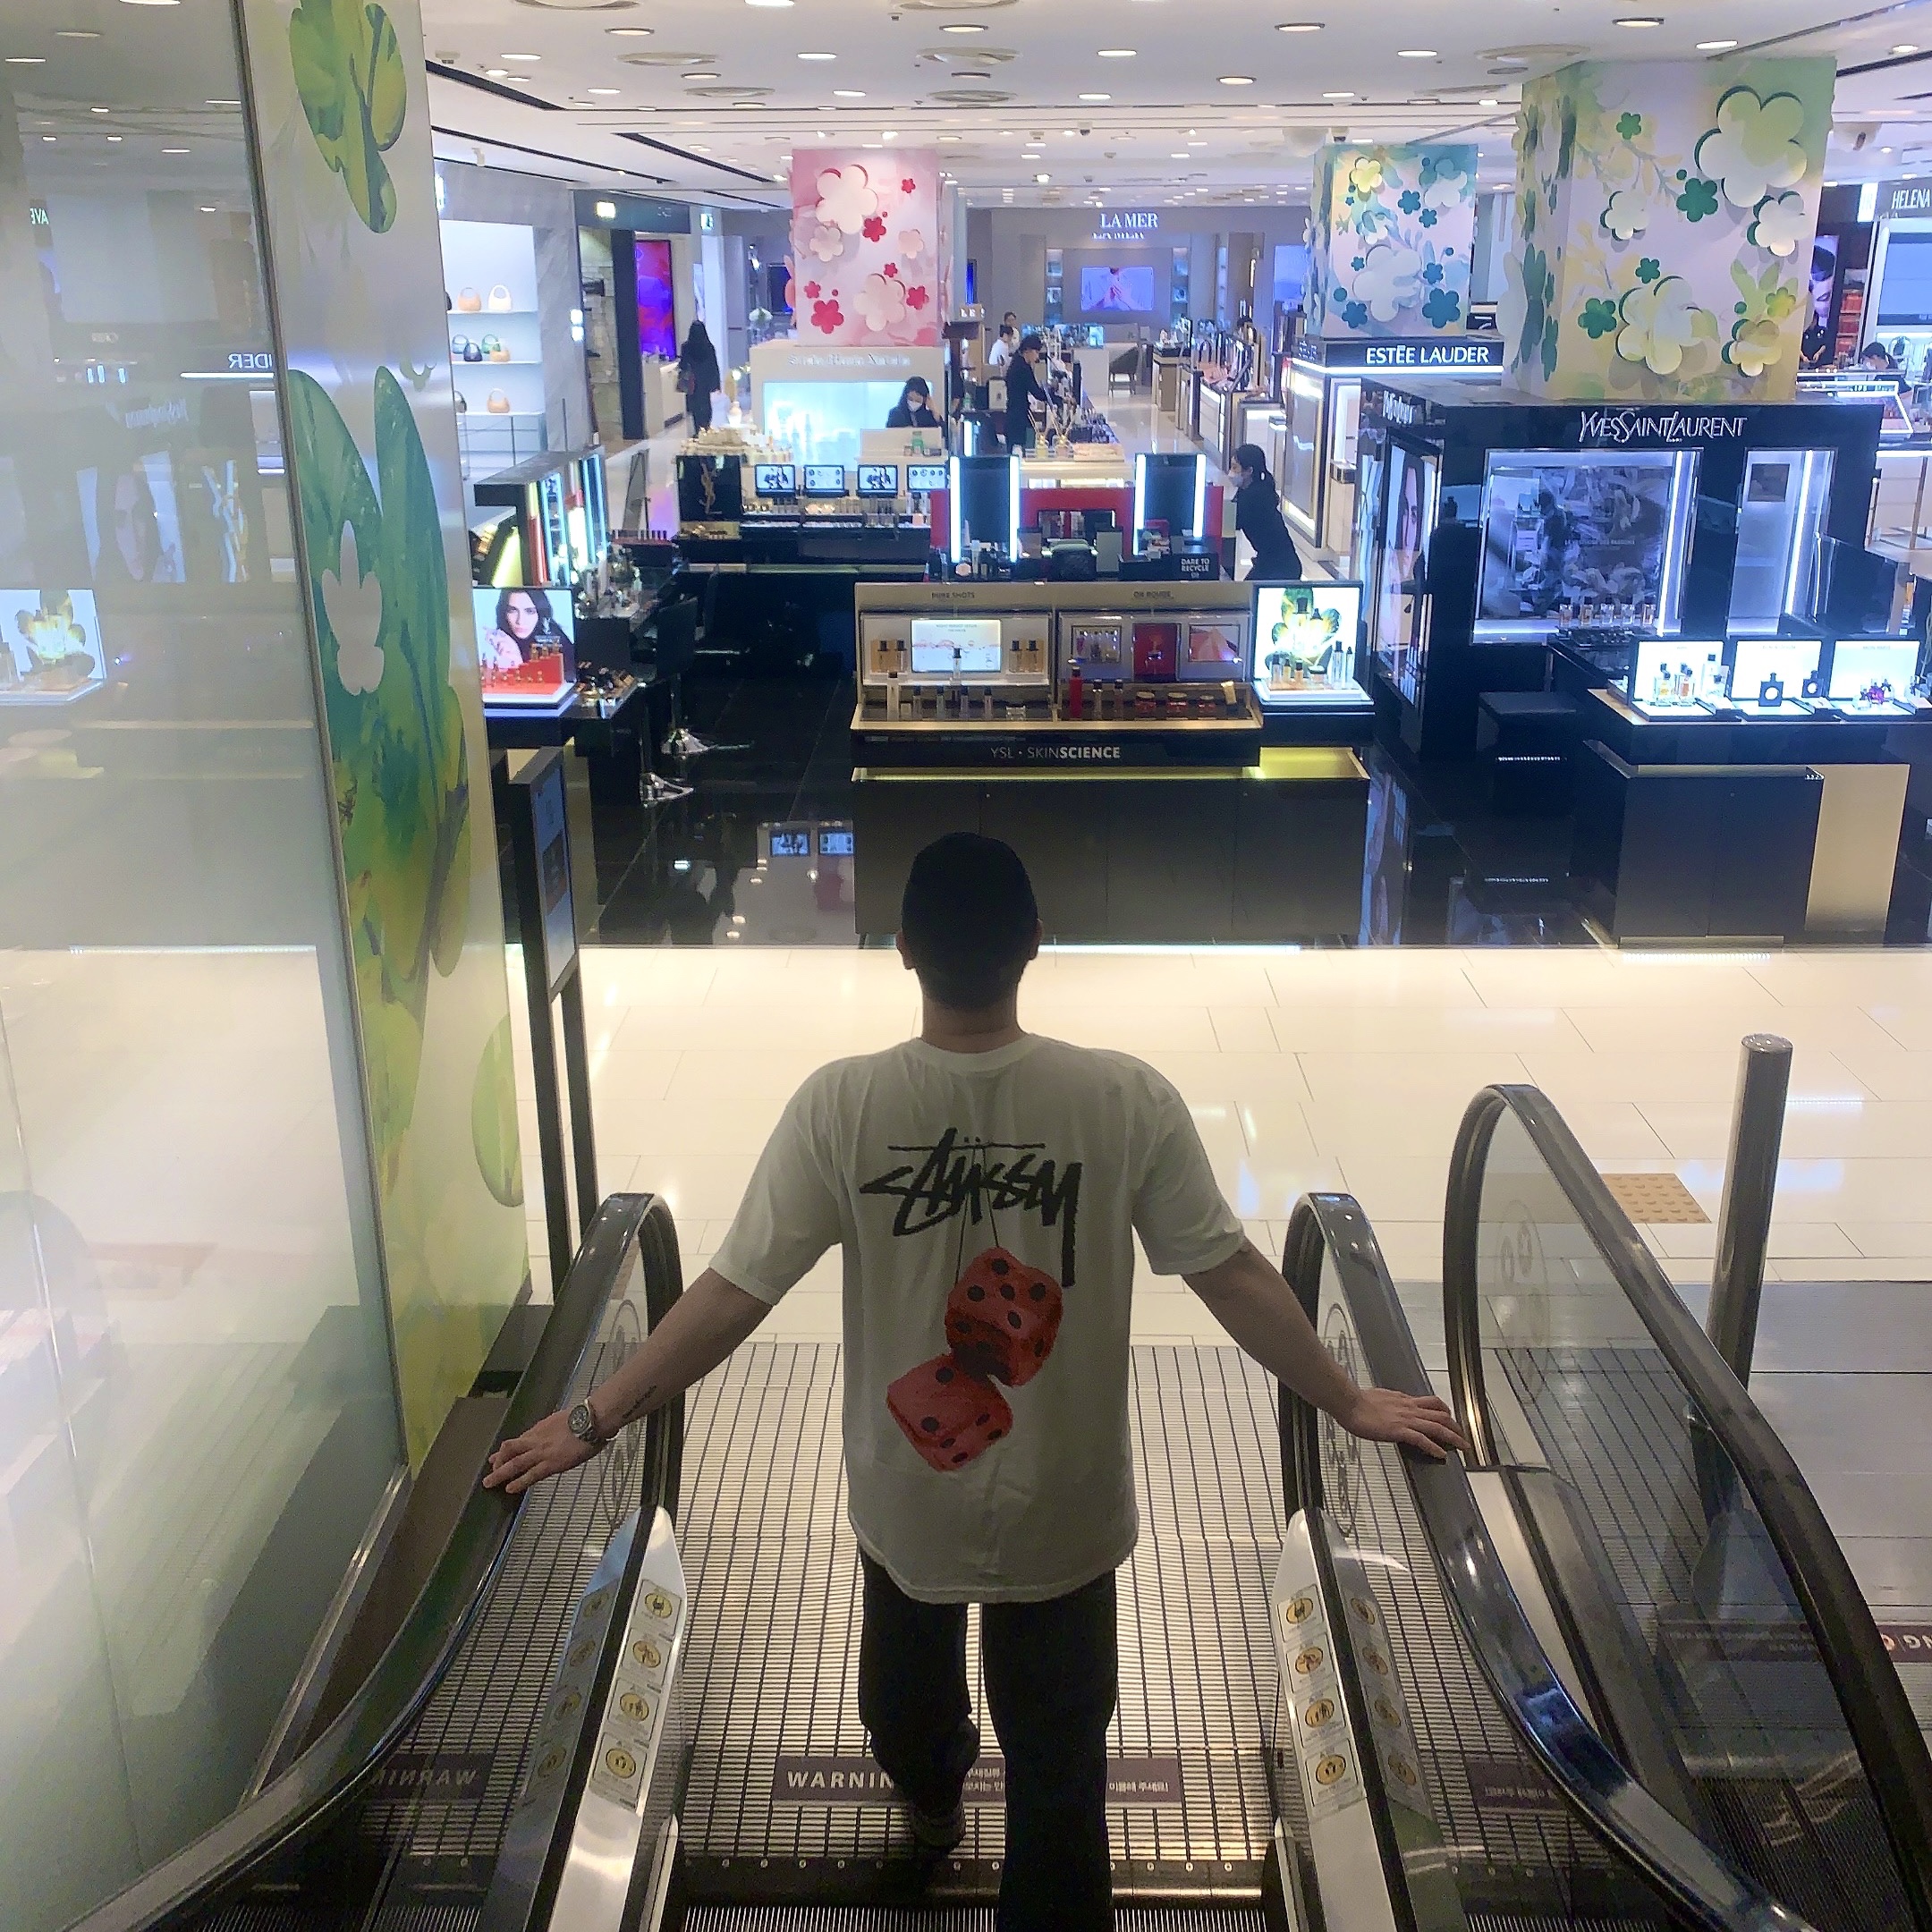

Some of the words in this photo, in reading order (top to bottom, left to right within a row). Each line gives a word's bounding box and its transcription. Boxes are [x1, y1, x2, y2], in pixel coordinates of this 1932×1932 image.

[1890, 188, 1930, 210] HELENA
[1100, 213, 1122, 228] LA
[1124, 212, 1158, 228] MER
[1420, 346, 1489, 363] LAUDER
[990, 747, 1014, 759] YSL
[1027, 746, 1121, 759] SKINSCIENCE
[787, 1770, 894, 1789] WARNIN
